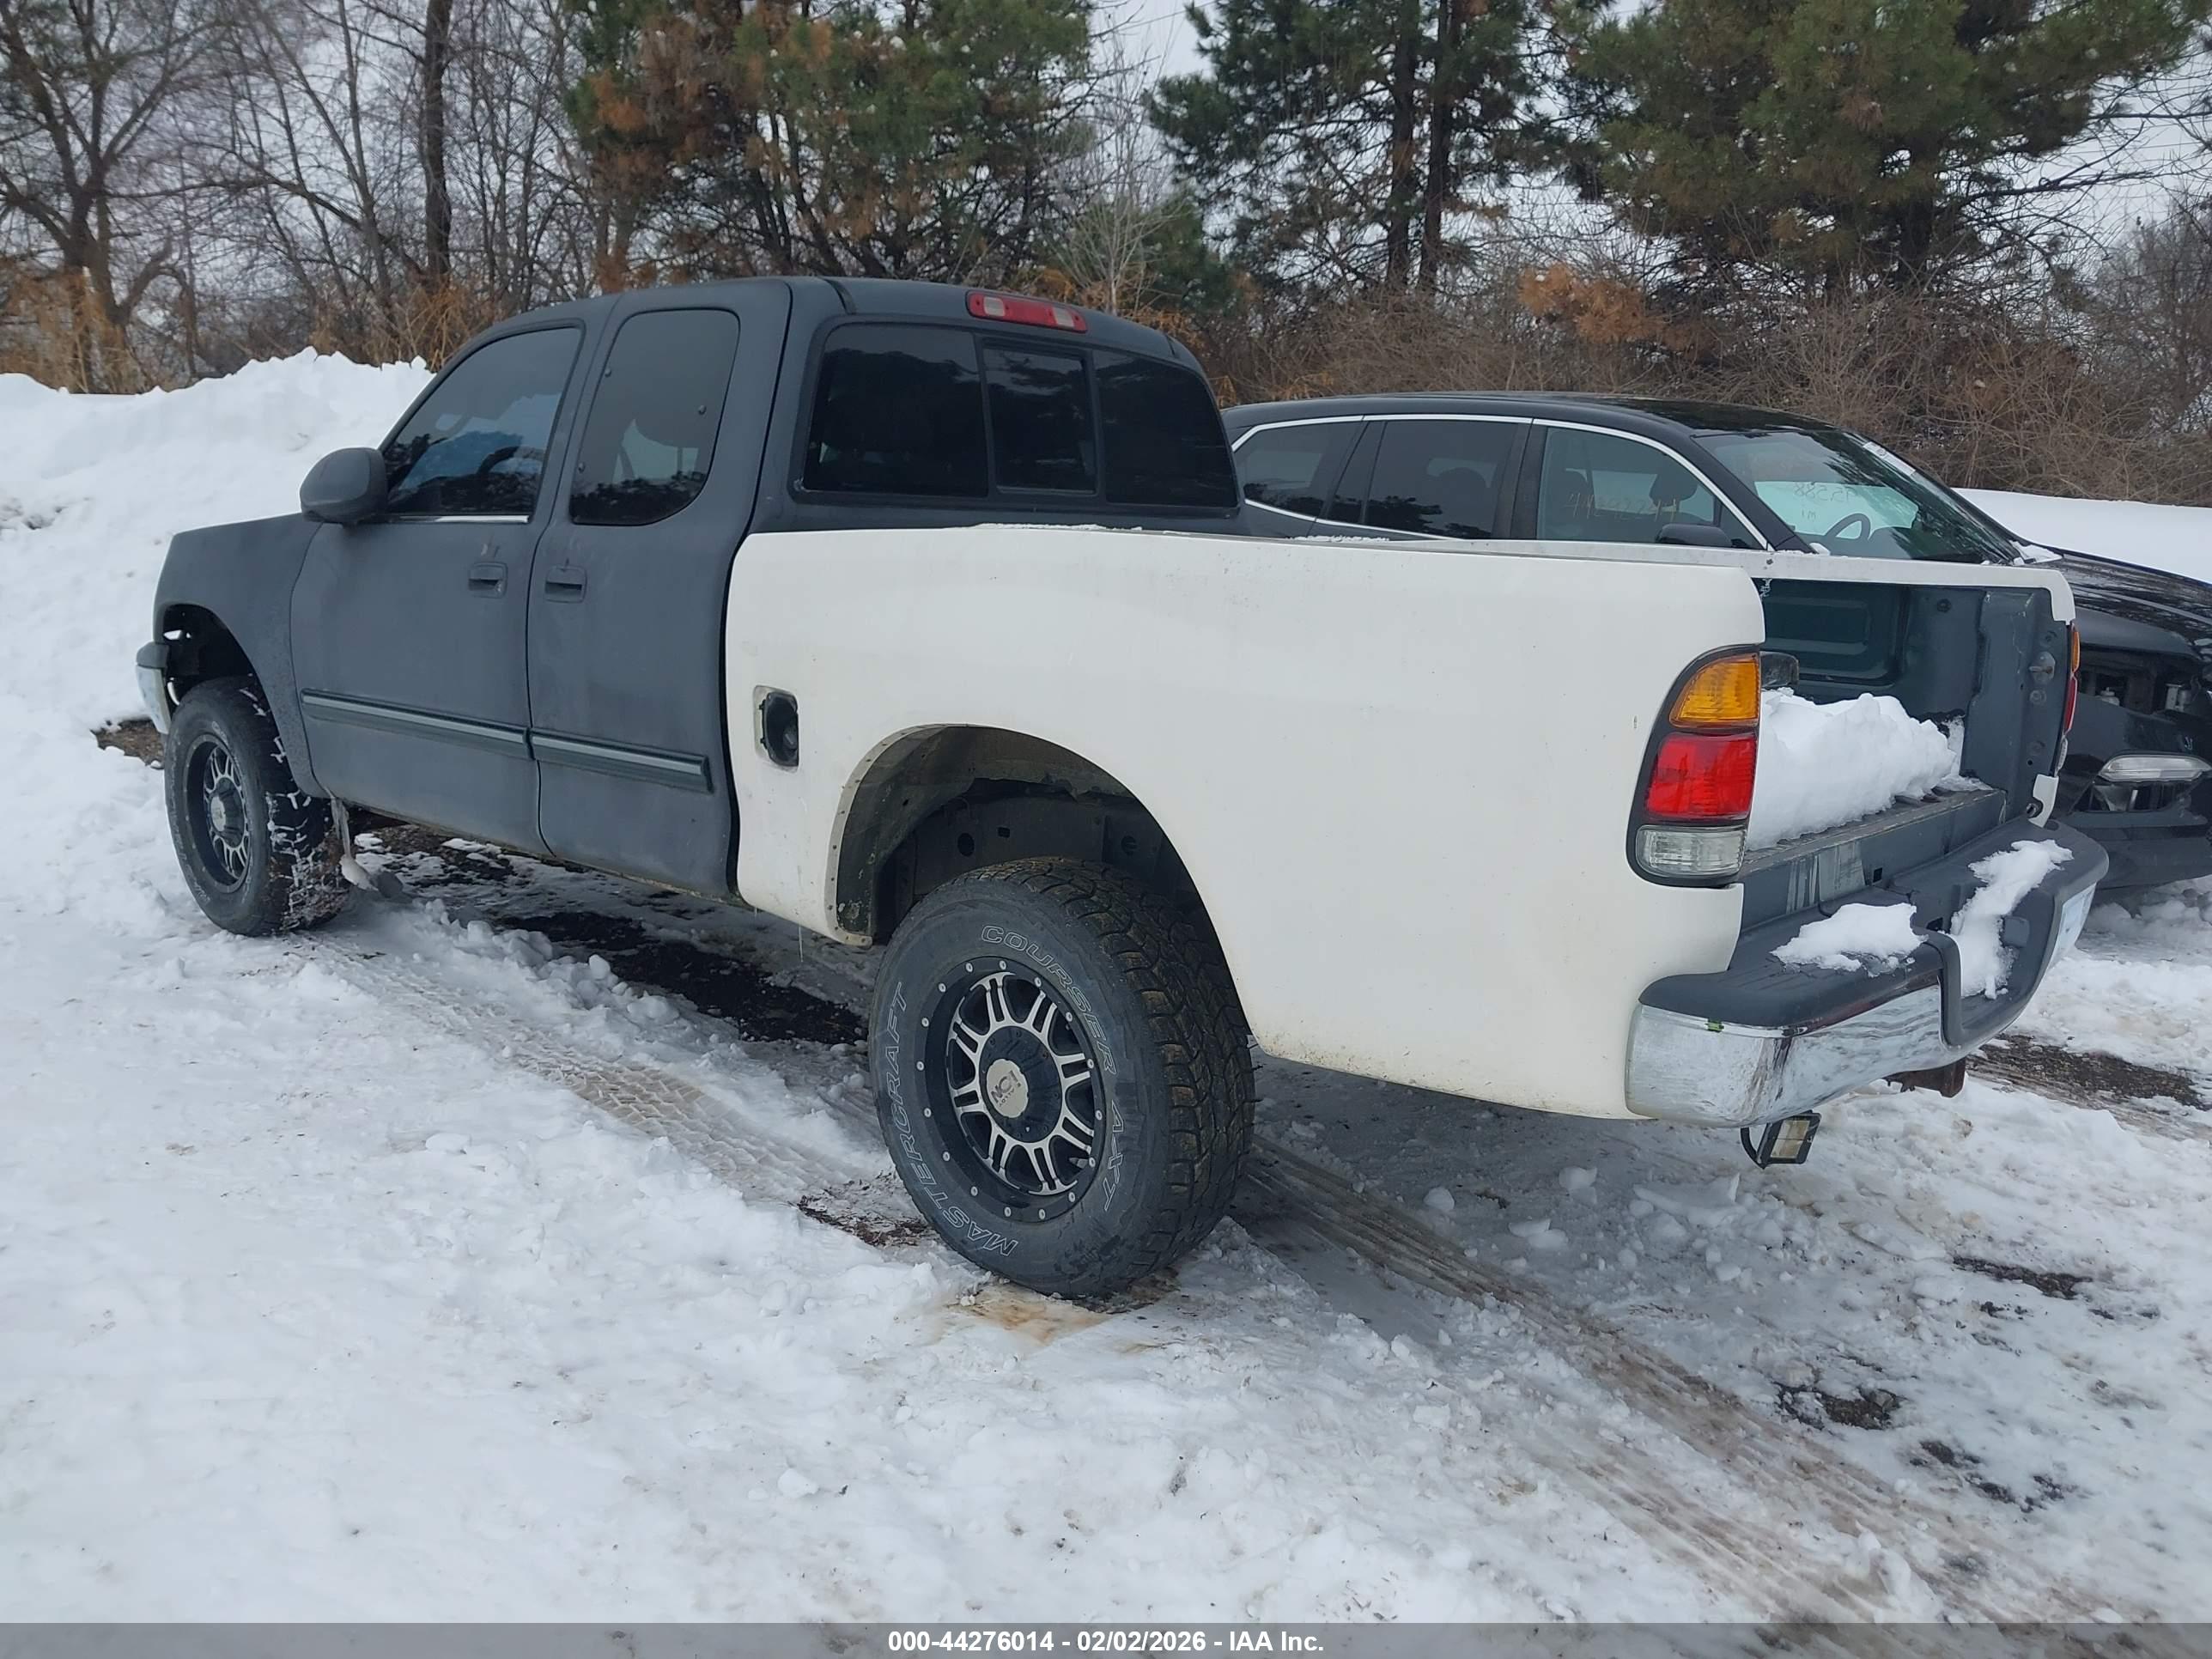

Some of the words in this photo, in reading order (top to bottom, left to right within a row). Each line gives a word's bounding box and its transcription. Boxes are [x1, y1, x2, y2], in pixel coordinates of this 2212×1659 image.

[885, 981, 1019, 1256] MASTERCRAFT
[981, 925, 1116, 1075] COURSER
[1103, 1099, 1124, 1212] AXT
